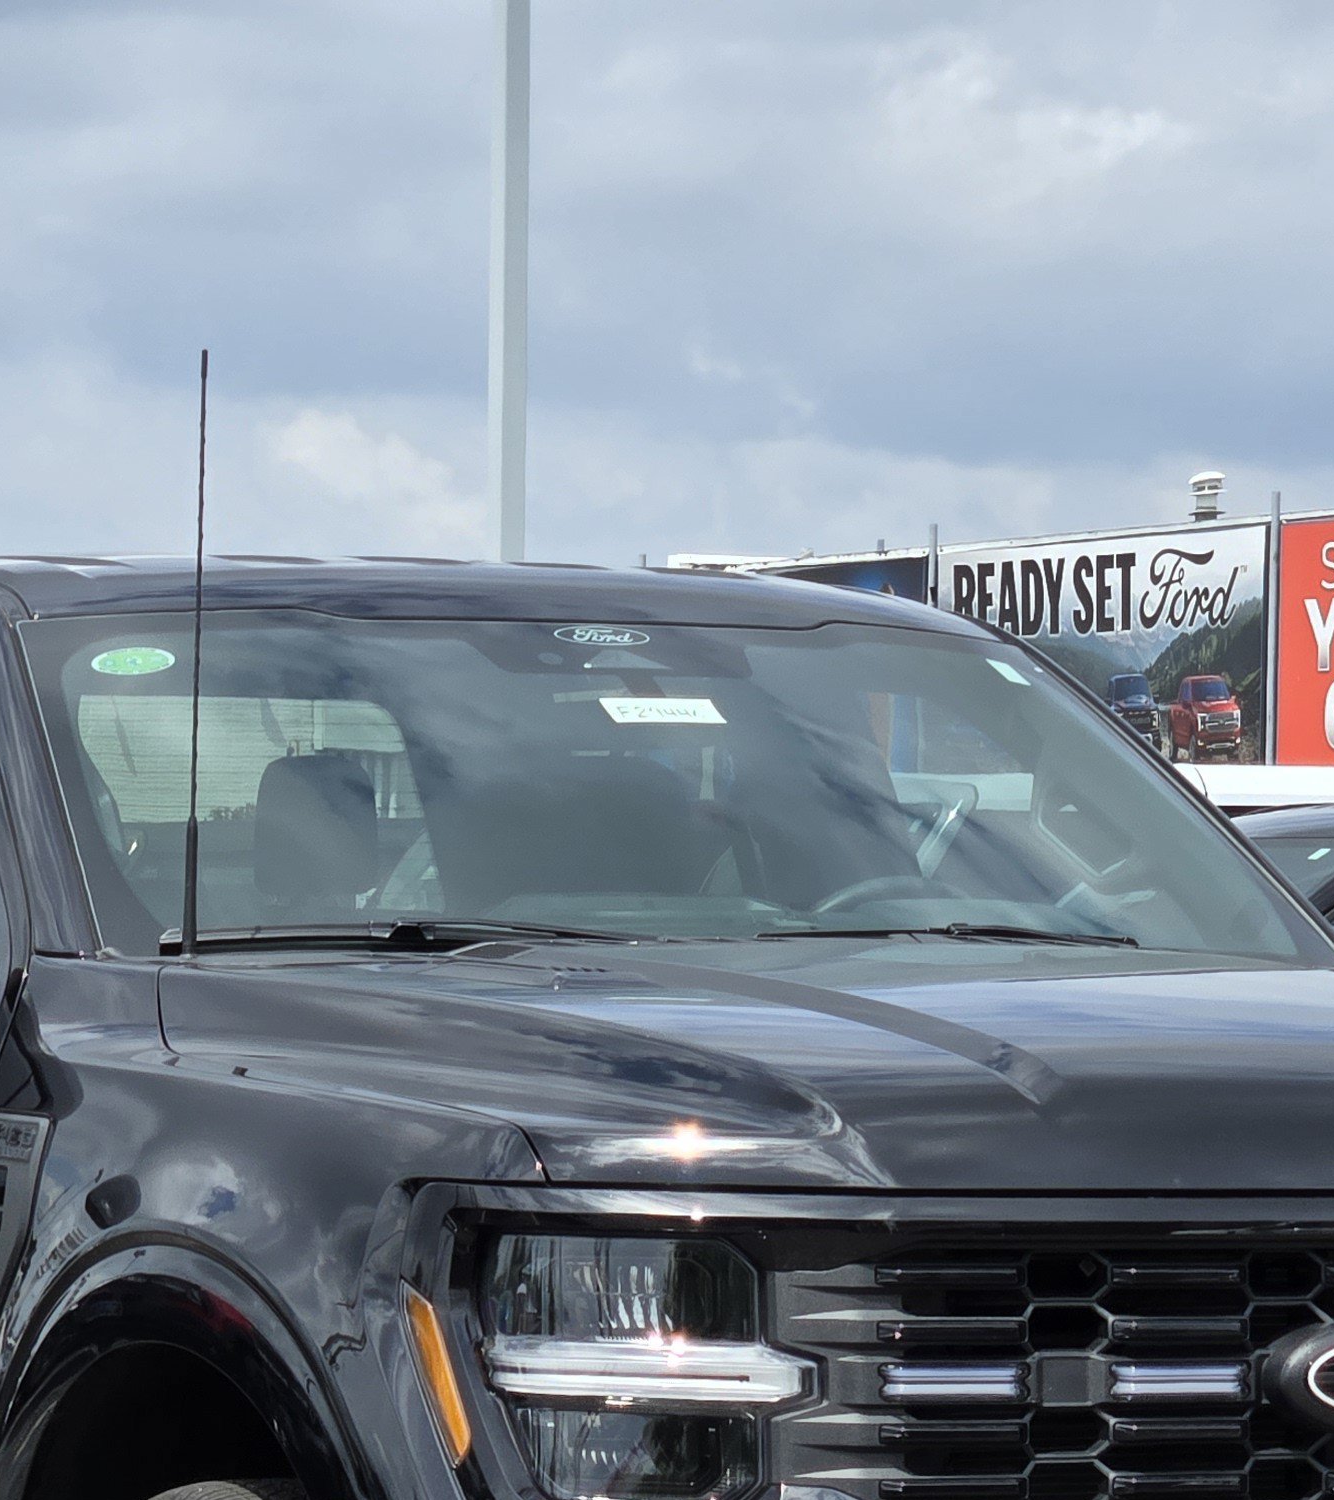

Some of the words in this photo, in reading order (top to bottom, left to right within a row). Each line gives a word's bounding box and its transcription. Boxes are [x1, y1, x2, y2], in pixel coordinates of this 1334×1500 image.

[953, 557, 1066, 636] READY
[1072, 552, 1136, 634] SET
[1138, 548, 1239, 629] Ford
[572, 628, 634, 643] Ford
